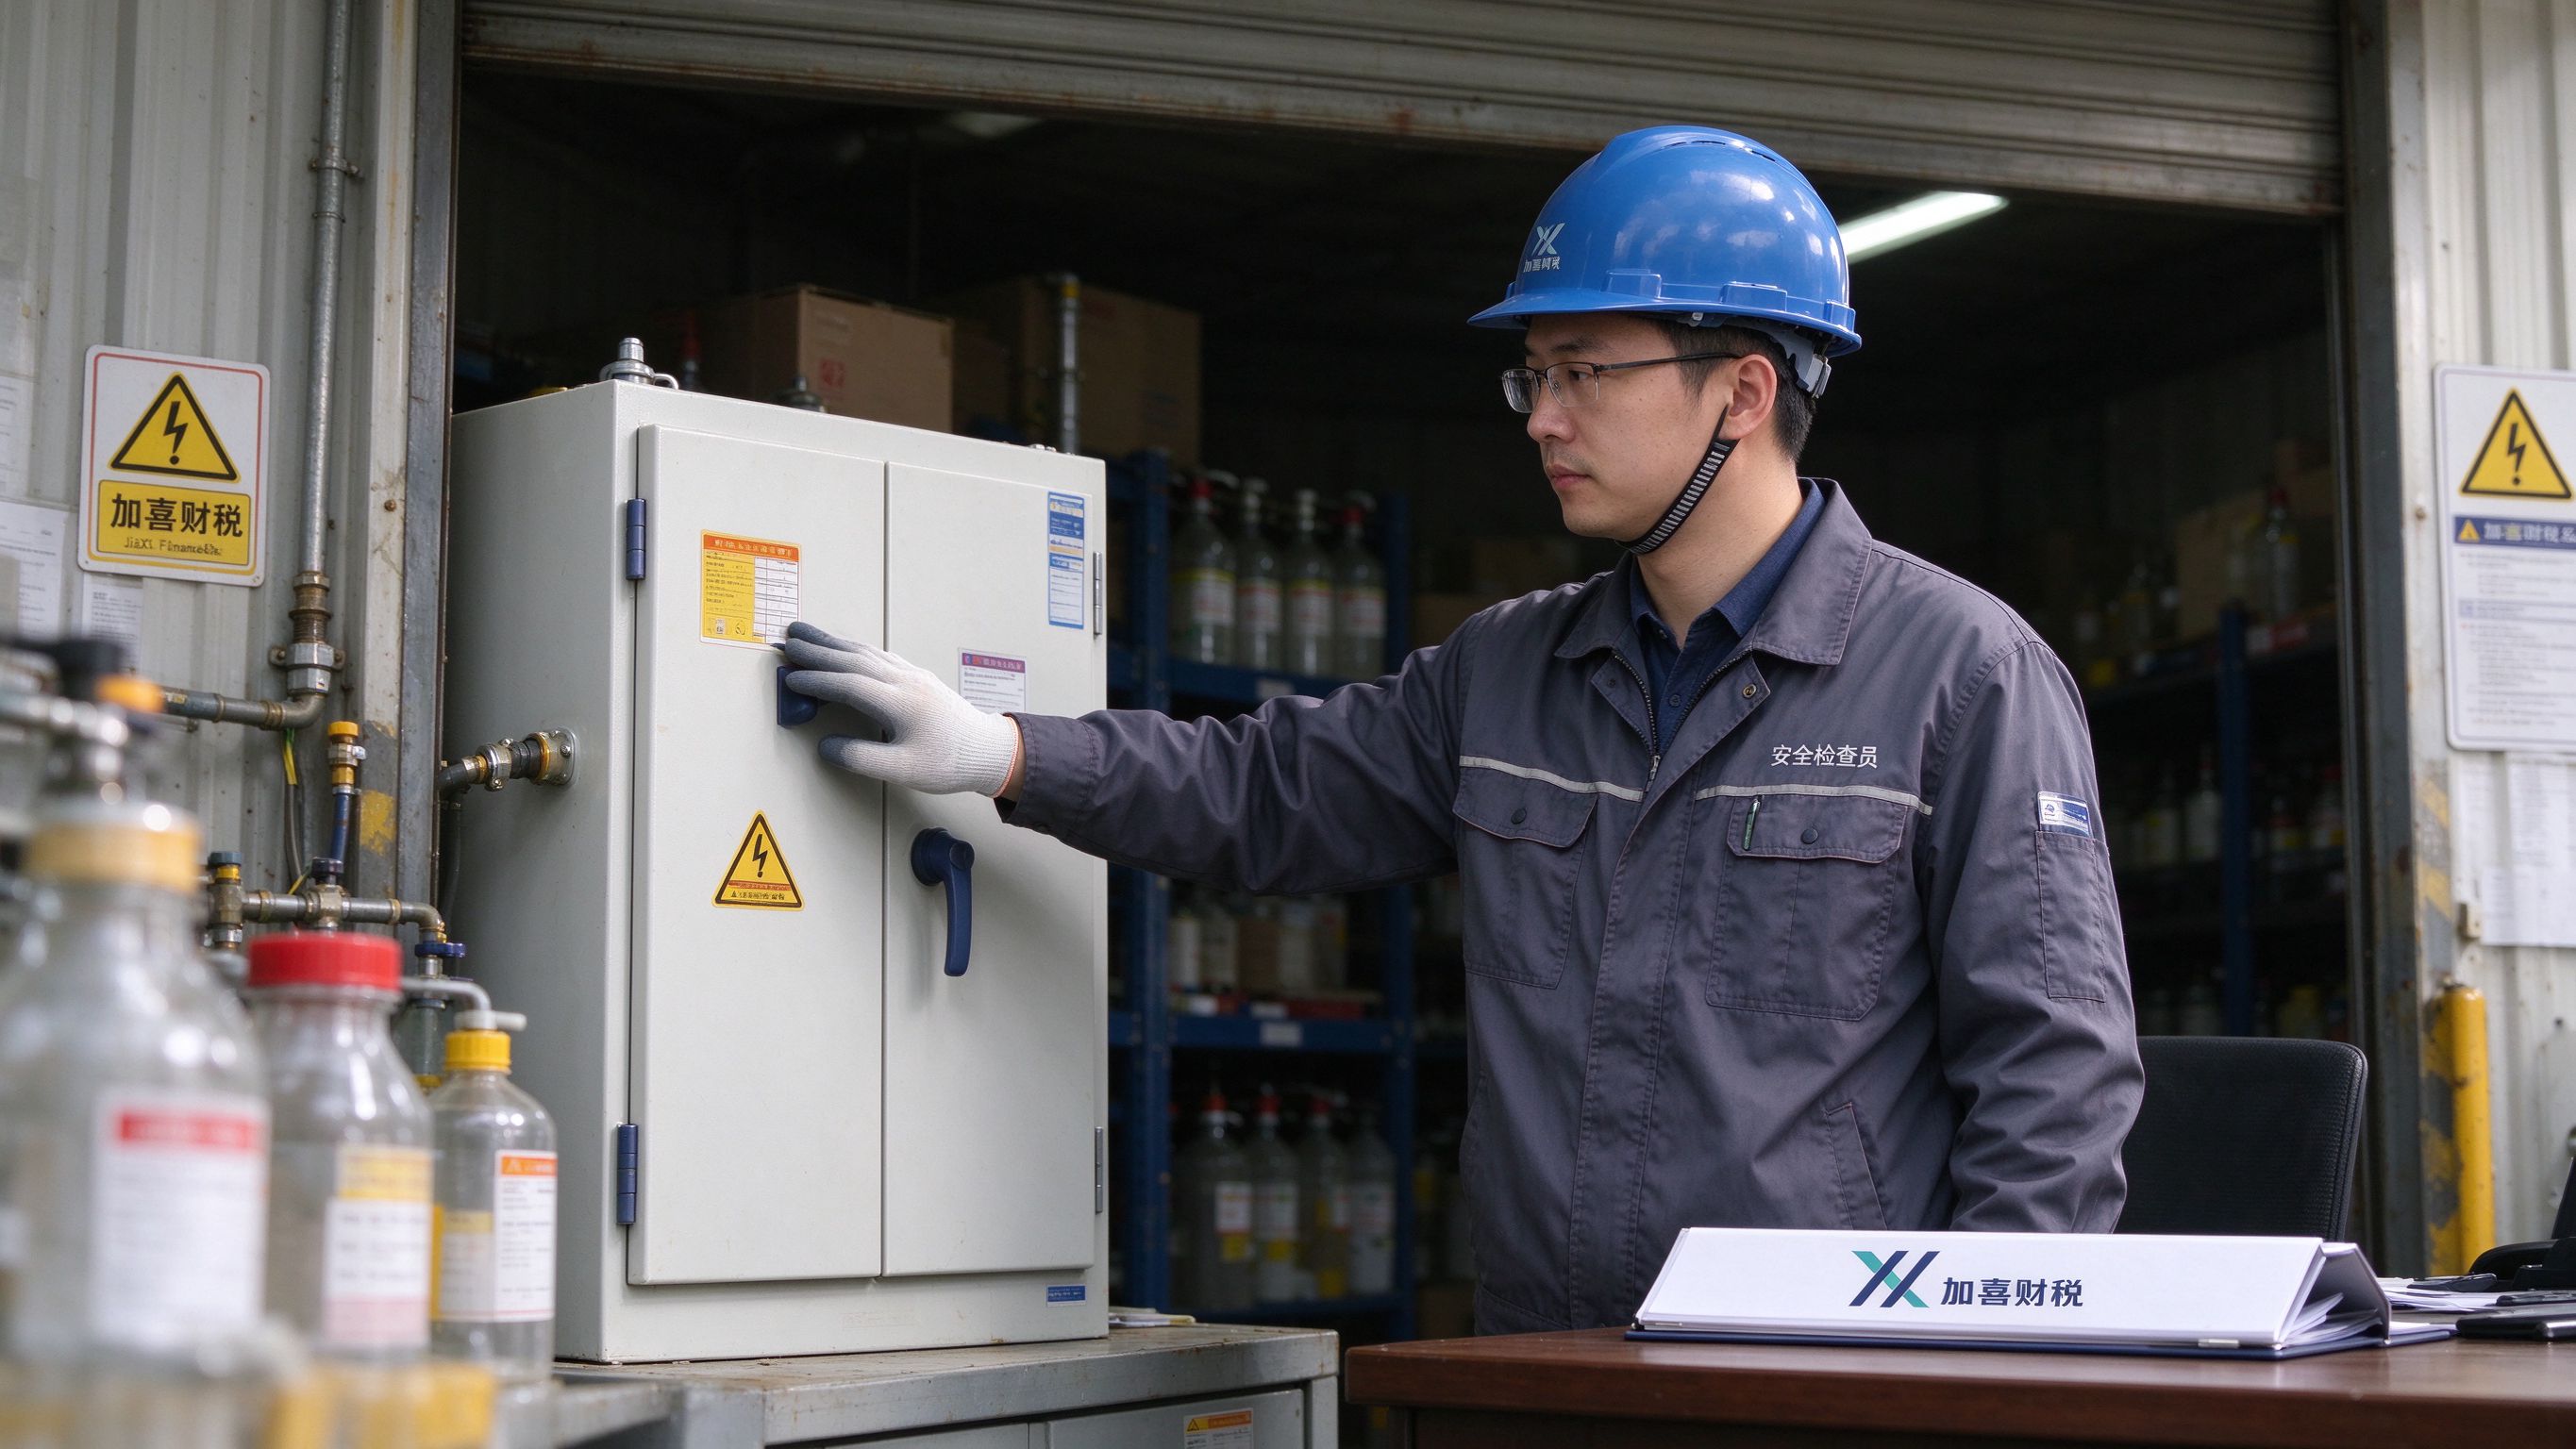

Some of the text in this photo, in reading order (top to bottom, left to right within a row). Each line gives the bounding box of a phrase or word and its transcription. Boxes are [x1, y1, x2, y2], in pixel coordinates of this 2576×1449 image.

[110, 492, 243, 538] 加喜财税
[1770, 743, 1879, 769] 安全检查员
[1940, 1276, 2084, 1307] 加喜财税
